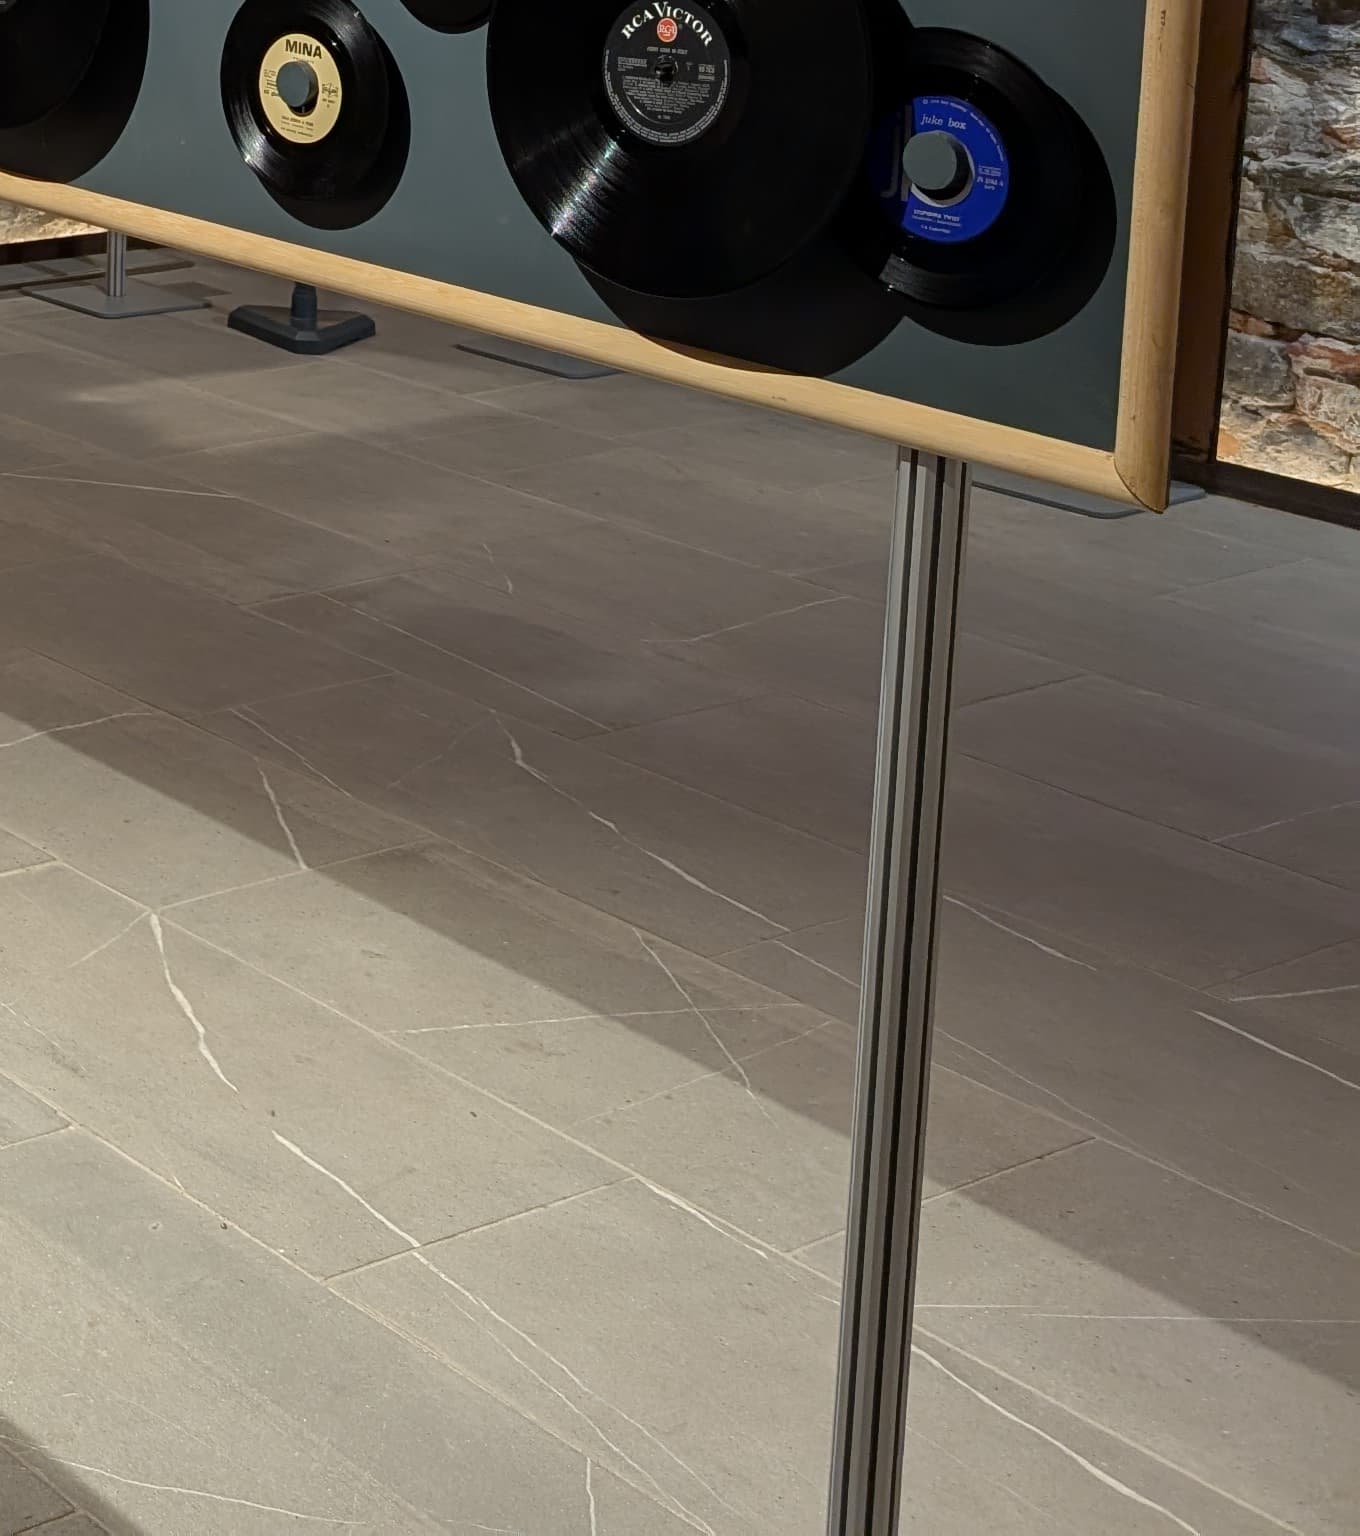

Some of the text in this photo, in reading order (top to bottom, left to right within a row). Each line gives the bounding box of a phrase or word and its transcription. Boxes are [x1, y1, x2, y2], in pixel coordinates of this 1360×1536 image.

[621, 9, 654, 39] RCA
[285, 39, 322, 59] MINA
[920, 114, 967, 130] juke box
